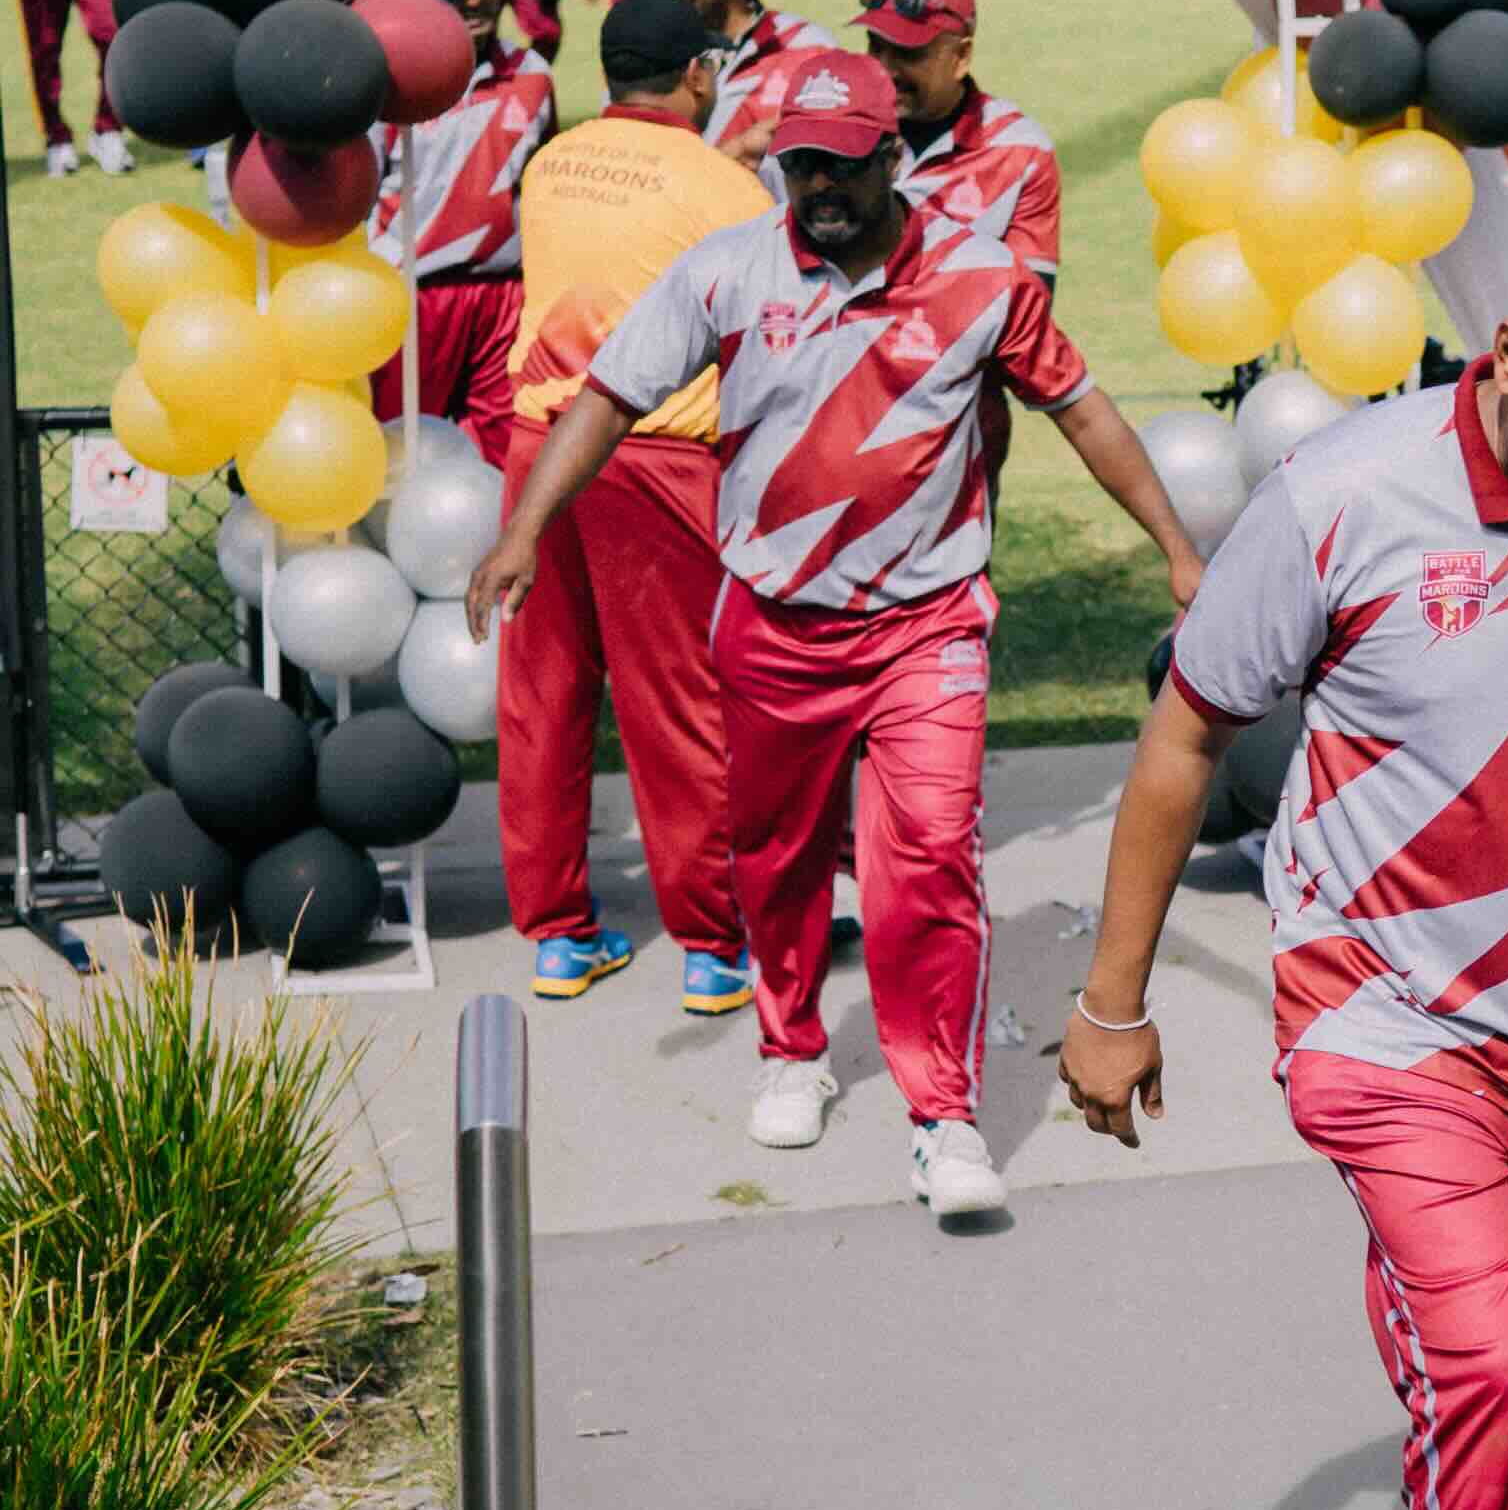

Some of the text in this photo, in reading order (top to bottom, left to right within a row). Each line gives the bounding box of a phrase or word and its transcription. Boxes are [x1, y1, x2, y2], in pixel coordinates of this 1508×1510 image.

[541, 158, 665, 193] MAROONS
[1428, 556, 1481, 570] BATTLE
[1421, 582, 1487, 599] MAROONS
